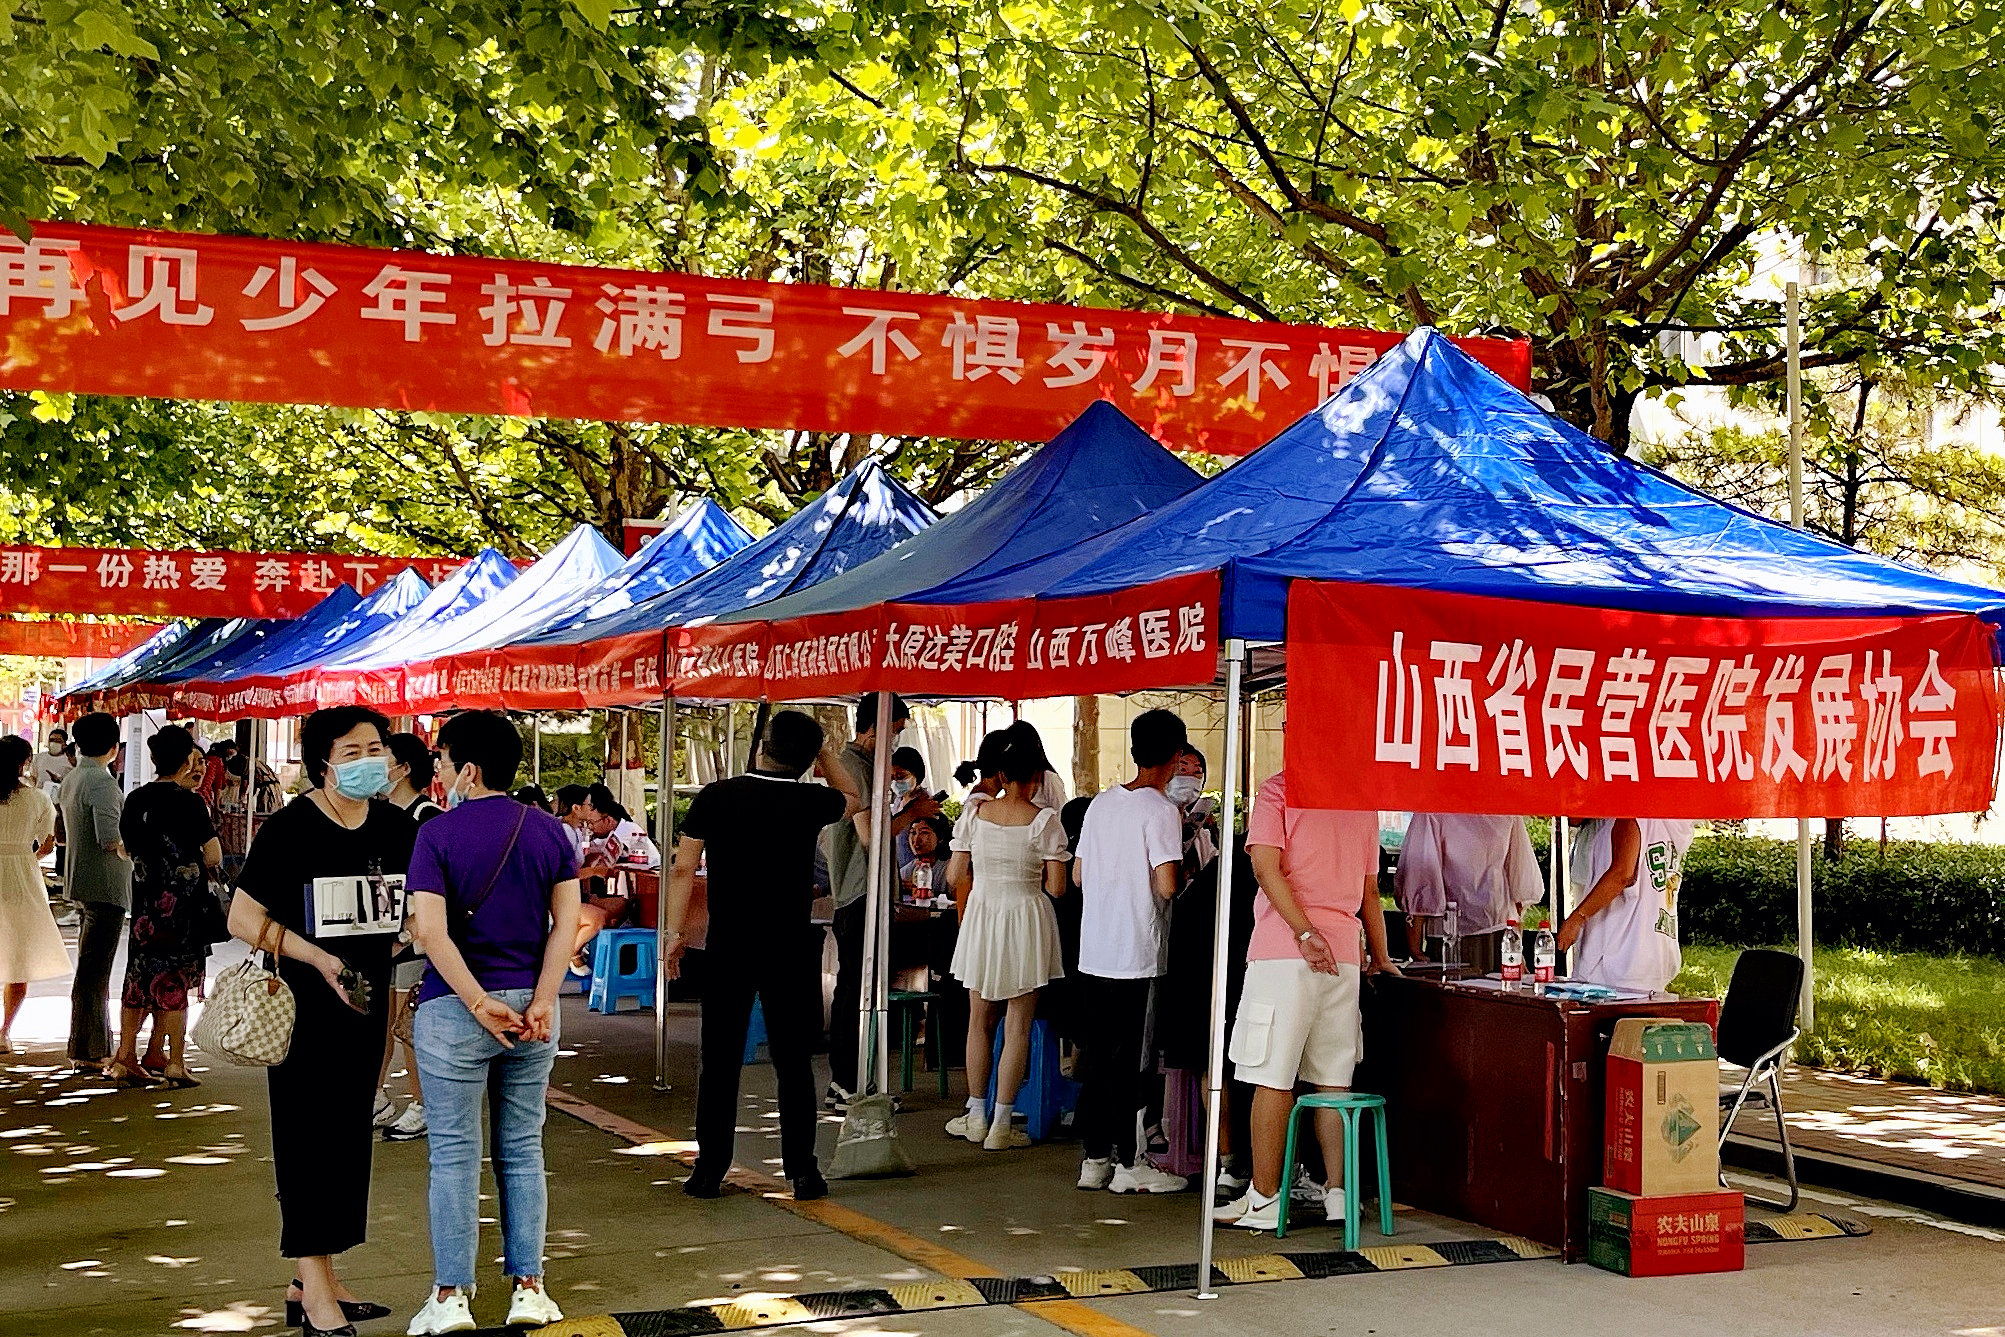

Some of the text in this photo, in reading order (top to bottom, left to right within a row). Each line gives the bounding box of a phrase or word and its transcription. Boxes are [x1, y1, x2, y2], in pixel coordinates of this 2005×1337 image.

[0, 234, 777, 364] 再见少年拉满弓
[0, 551, 228, 592] 那一份热爱
[882, 622, 1019, 672] 太原达美口腔
[1026, 602, 1206, 670] 山西万峰医院
[1374, 631, 1957, 782] 山西省民营医院发展协会
[1657, 1212, 1720, 1235] 农夫山泉
